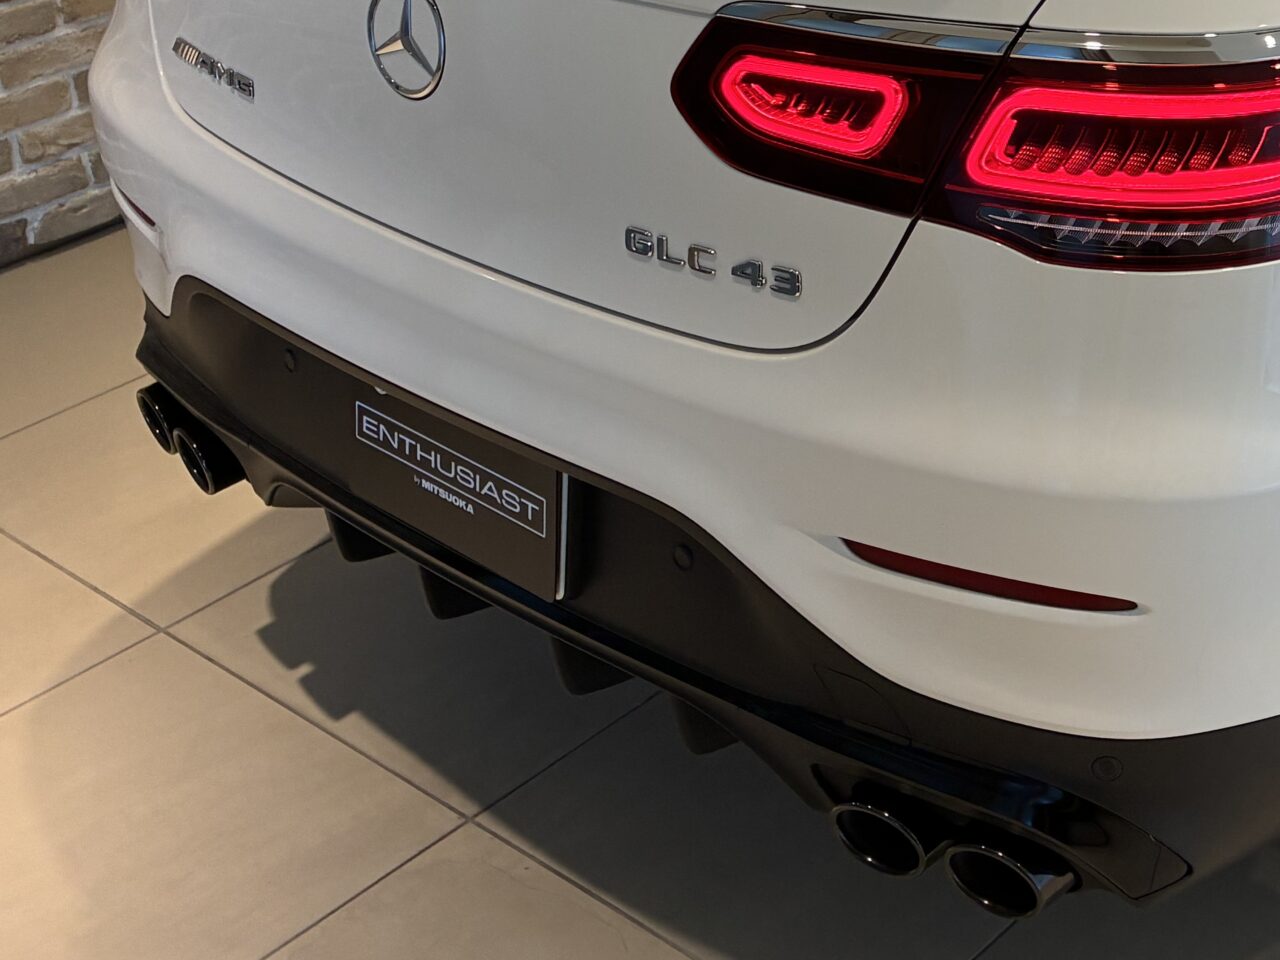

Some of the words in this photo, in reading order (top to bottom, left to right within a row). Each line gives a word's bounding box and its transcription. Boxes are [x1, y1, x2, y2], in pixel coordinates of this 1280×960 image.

[625, 226, 717, 276] GLC
[731, 259, 802, 297] 43
[362, 415, 540, 521] ENTHUSIAST
[421, 478, 475, 515] MITSUOKA
